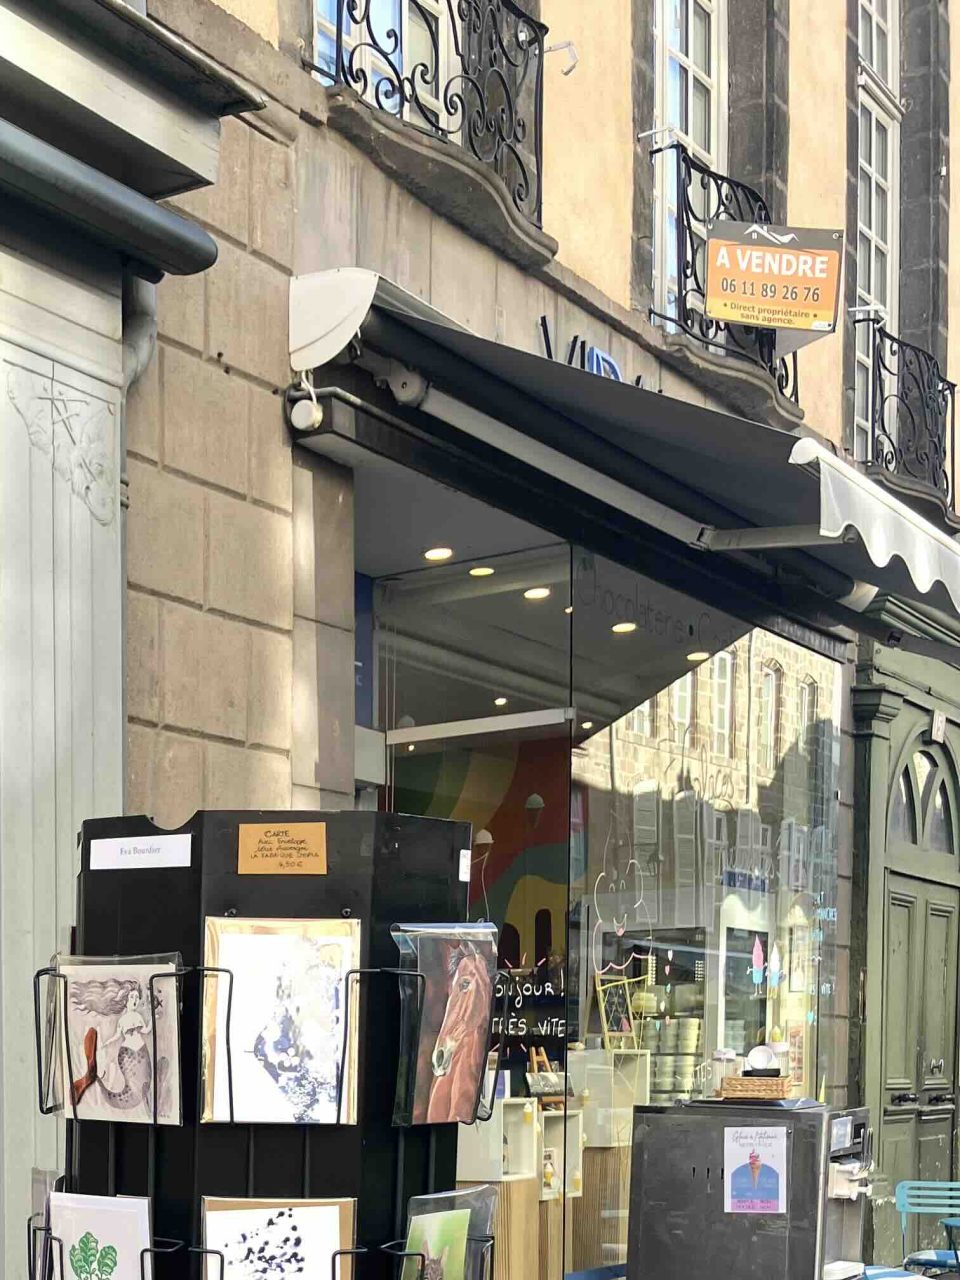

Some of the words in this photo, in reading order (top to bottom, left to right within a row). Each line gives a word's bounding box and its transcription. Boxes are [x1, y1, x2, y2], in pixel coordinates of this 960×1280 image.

[716, 246, 731, 269] A
[736, 249, 829, 278] VENDRE
[721, 277, 736, 293] 06
[742, 281, 756, 296] 11
[761, 283, 777, 298] 89
[782, 285, 798, 301] 26
[803, 287, 820, 302] 76
[730, 302, 756, 313] Direct
[757, 305, 810, 319] propriétaire
[740, 312, 759, 321] sans
[761, 315, 796, 325] agence.
